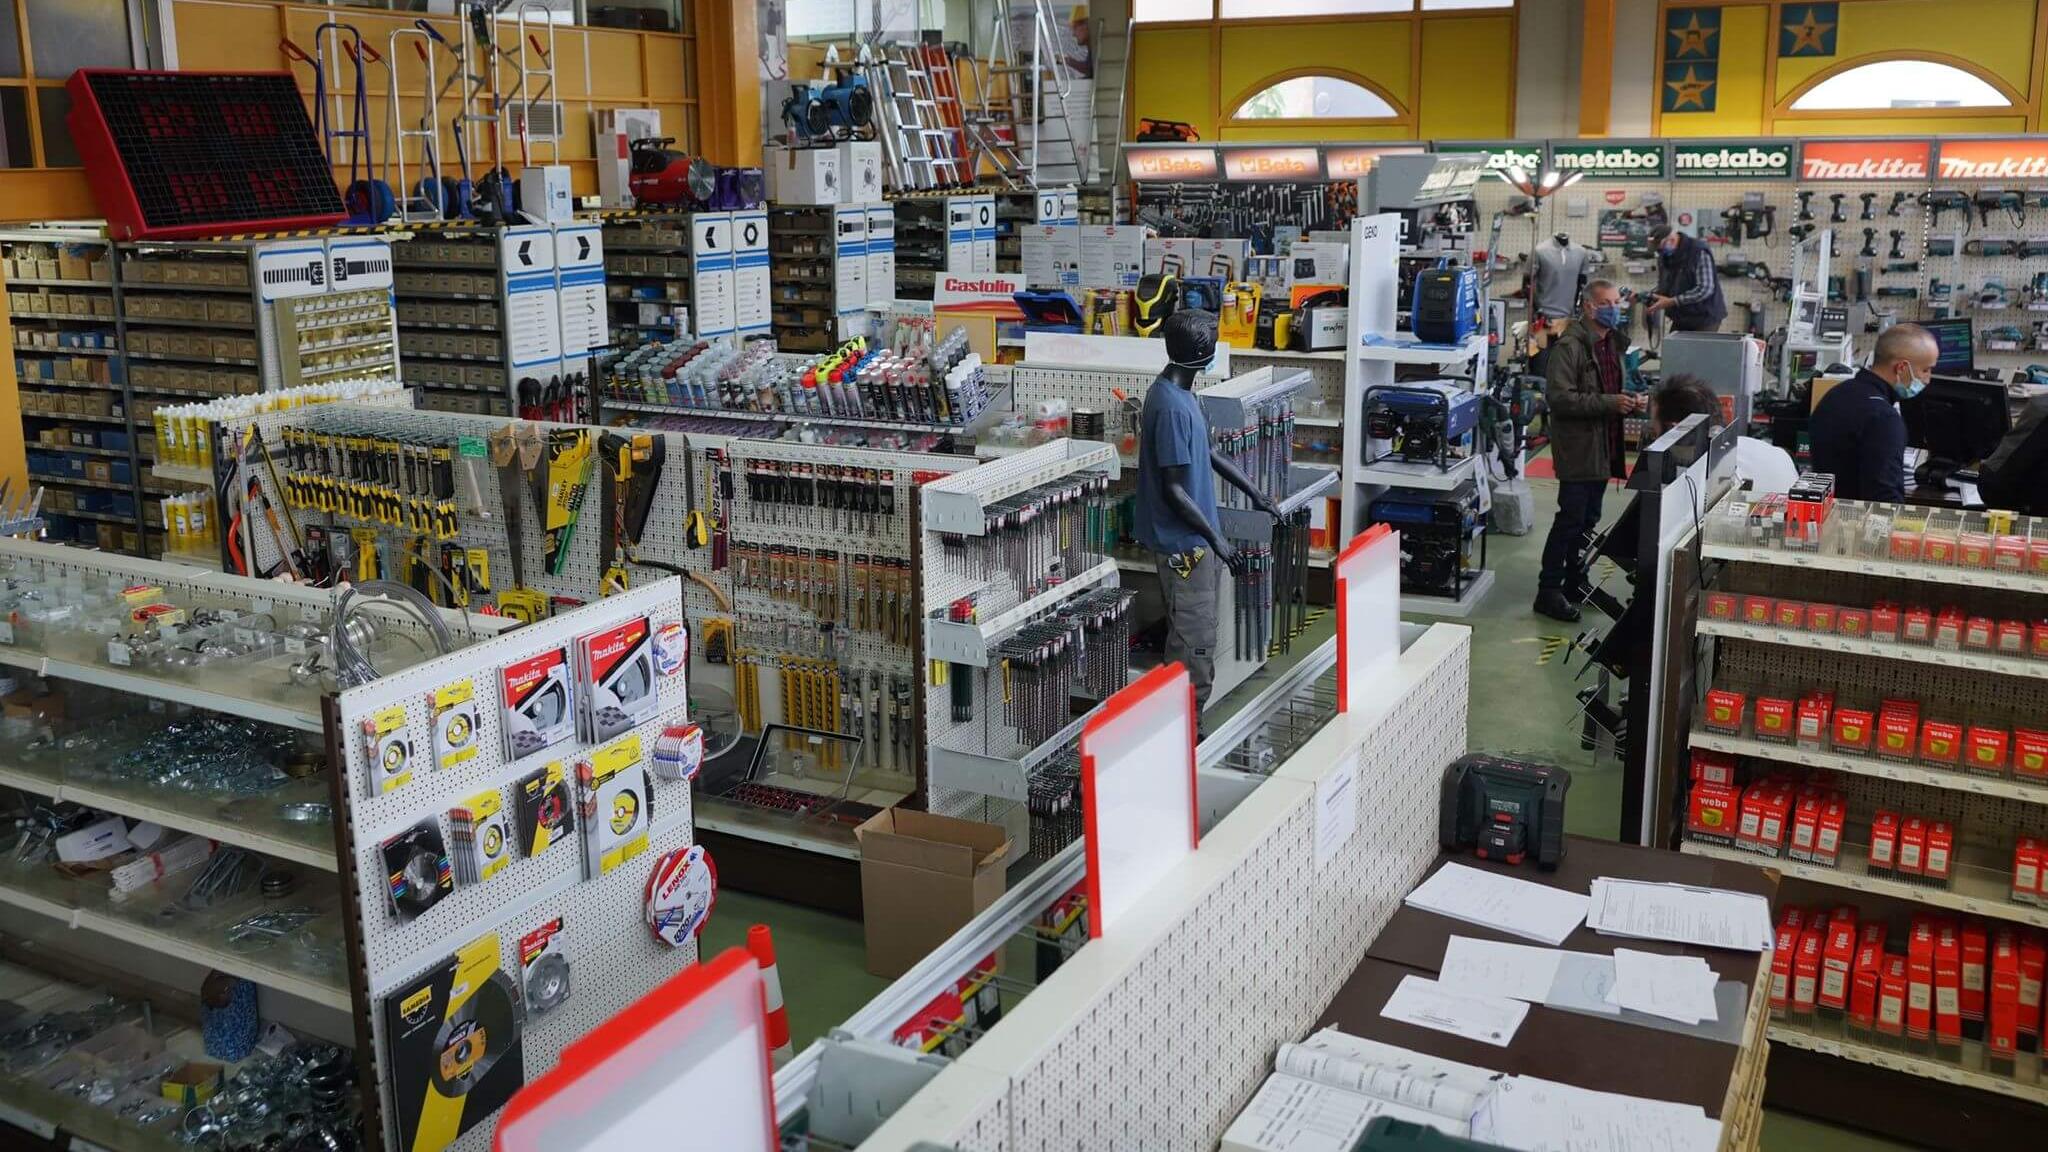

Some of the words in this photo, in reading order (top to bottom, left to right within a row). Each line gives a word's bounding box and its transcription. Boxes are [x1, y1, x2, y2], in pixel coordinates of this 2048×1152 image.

[1158, 158, 1204, 172] Beta
[1258, 158, 1304, 172] Beta
[1555, 149, 1659, 168] metabo
[1676, 147, 1787, 168] metabo
[1803, 158, 1927, 179] makita
[1939, 157, 2048, 179] makit
[944, 278, 1016, 293] Castolin
[662, 863, 691, 900] LENOX
